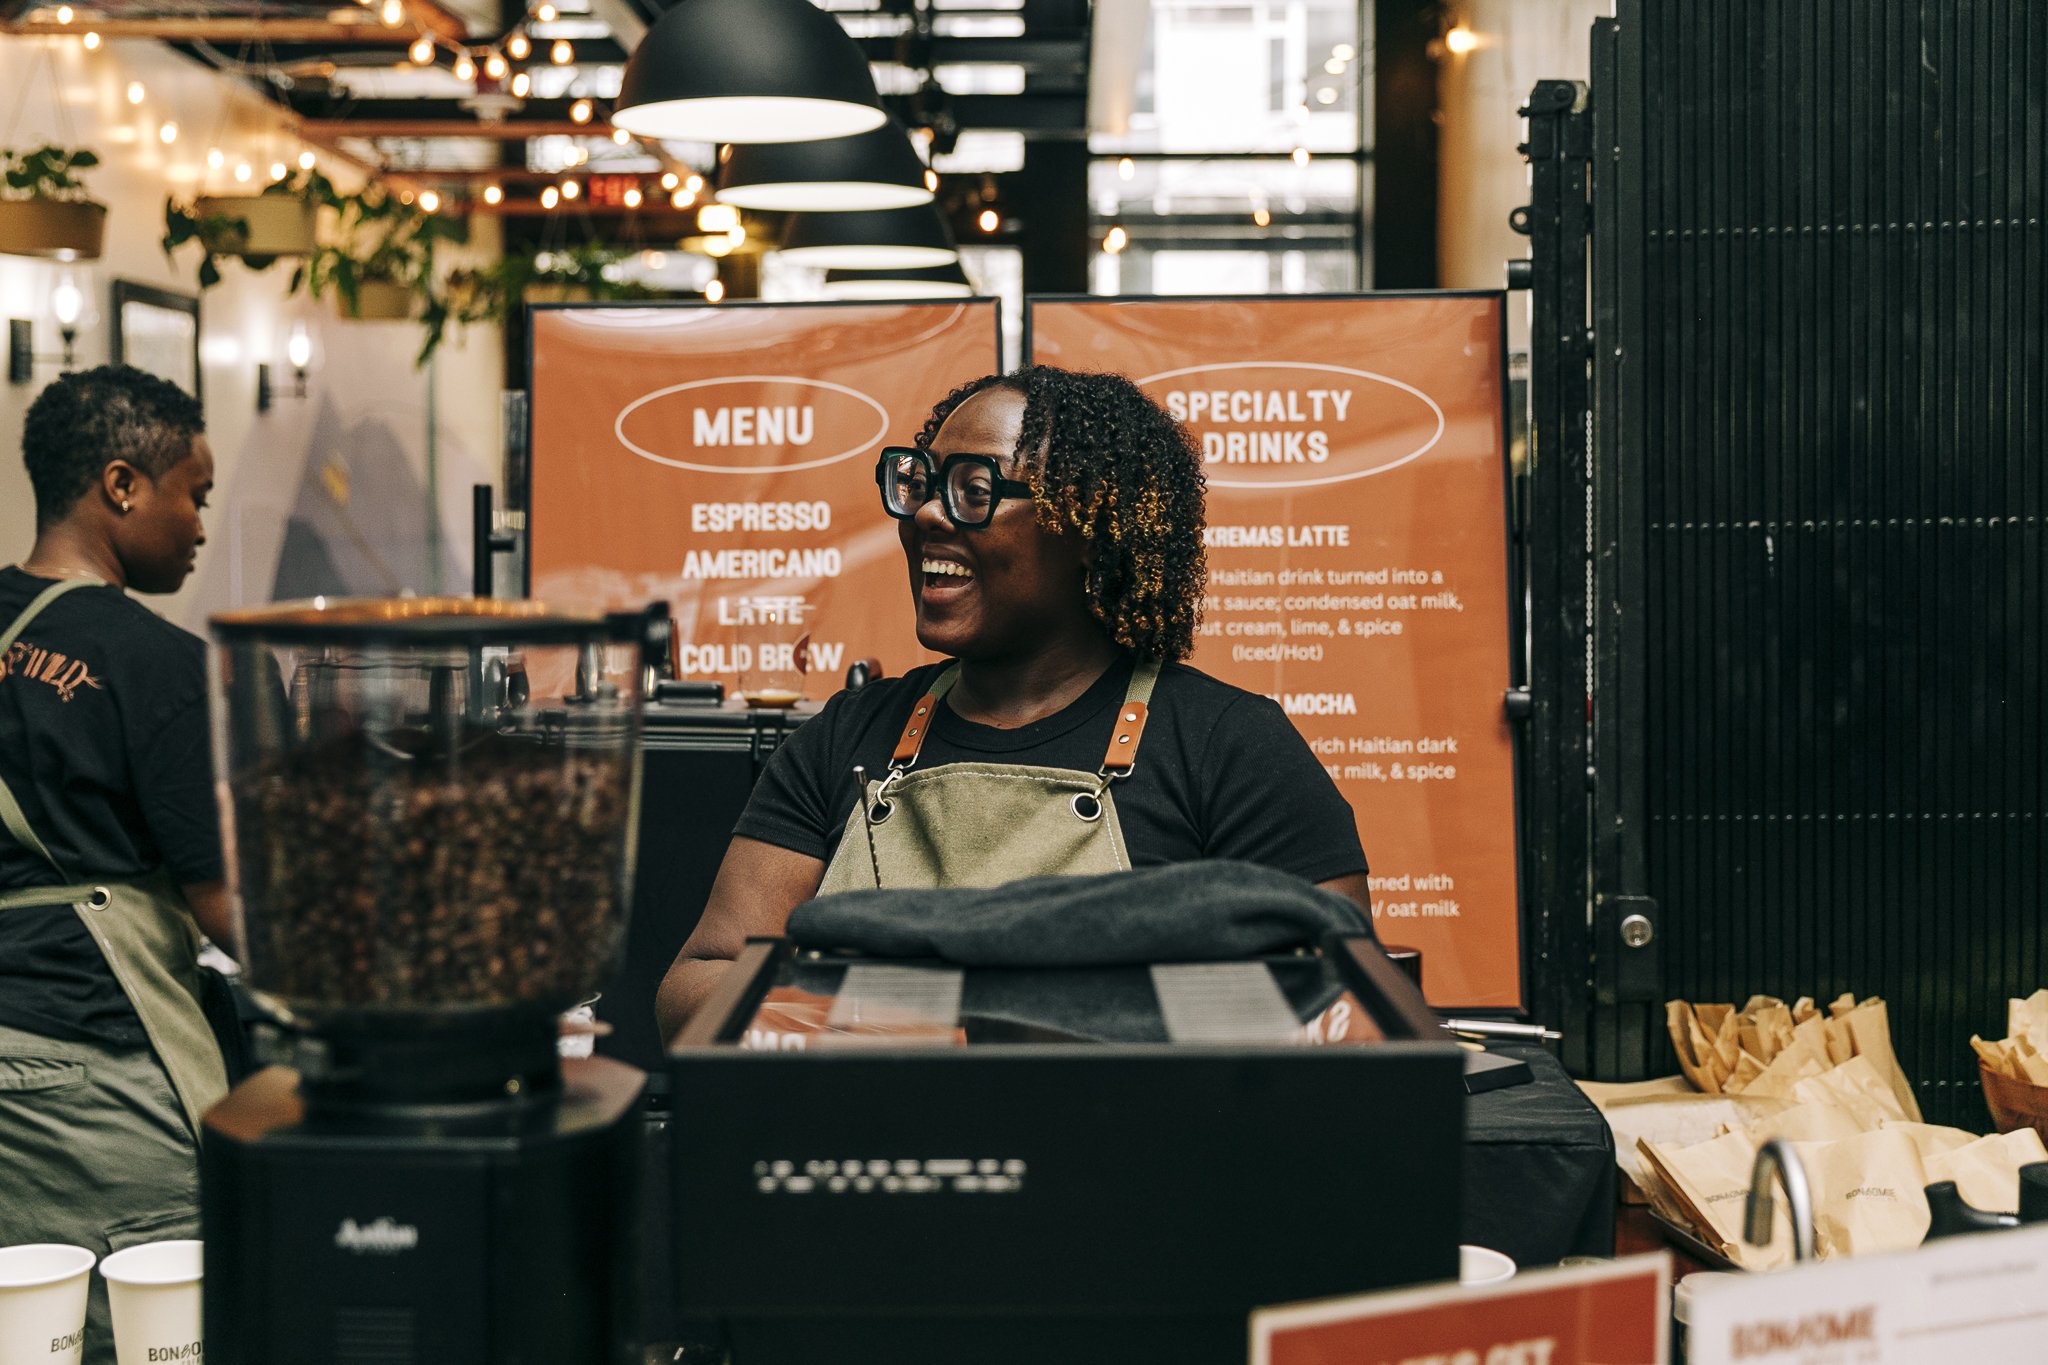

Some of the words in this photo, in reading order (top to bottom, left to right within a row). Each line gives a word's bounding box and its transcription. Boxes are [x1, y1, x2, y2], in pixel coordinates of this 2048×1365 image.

[1166, 389, 1352, 423] SPECIALTY
[693, 406, 814, 447] MENU
[1203, 431, 1329, 464] DRINKS
[691, 501, 831, 532] ESPRESSO
[1204, 526, 1284, 548] KREMAS
[1287, 525, 1350, 547] LATTE
[681, 548, 842, 580] AMERICANO
[1211, 567, 1274, 586] Haitian
[1277, 567, 1324, 586] drink
[1327, 567, 1389, 586] turned
[1391, 567, 1429, 585] into
[1431, 569, 1444, 585] a
[718, 595, 806, 626] LATTE
[1284, 593, 1384, 610] condensed
[1386, 594, 1418, 610] oat
[1420, 591, 1464, 612] milk,
[1225, 621, 1287, 639] cream,
[1291, 618, 1335, 638] lime,
[1337, 618, 1351, 635] &
[1354, 617, 1403, 639] spice
[679, 643, 752, 673] COLD
[759, 642, 844, 673] BRW
[1232, 643, 1323, 662] (Iced/Hot)
[1283, 692, 1357, 715] MOCHA
[1310, 736, 1345, 753] rich
[1349, 736, 1413, 753] Haitian
[1416, 736, 1458, 753] dark
[1344, 763, 1387, 782] milk,
[1390, 763, 1404, 780] &
[1407, 762, 1456, 782] spice
[1413, 873, 1454, 891] with
[1386, 901, 1418, 917] oat
[1421, 900, 1460, 917] milk
